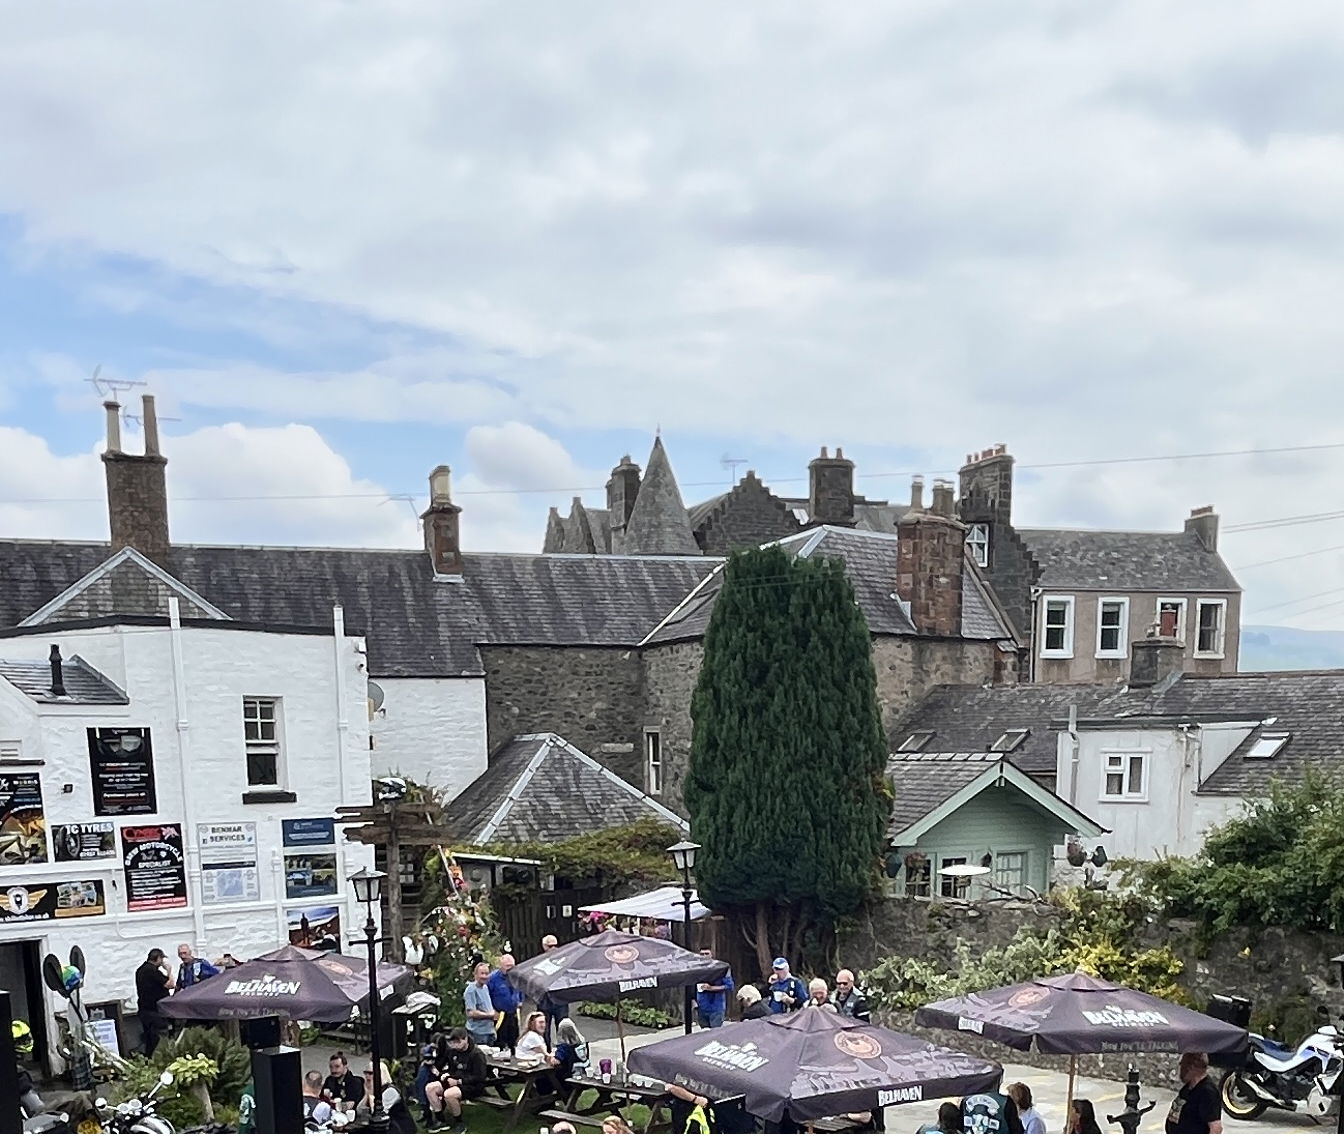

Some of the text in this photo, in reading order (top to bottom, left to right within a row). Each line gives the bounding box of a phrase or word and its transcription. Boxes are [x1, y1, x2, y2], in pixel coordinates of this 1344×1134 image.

[80, 822, 114, 834] TYRES
[209, 834, 245, 842] SERVICES
[877, 1085, 923, 1107] BELHAVEN
